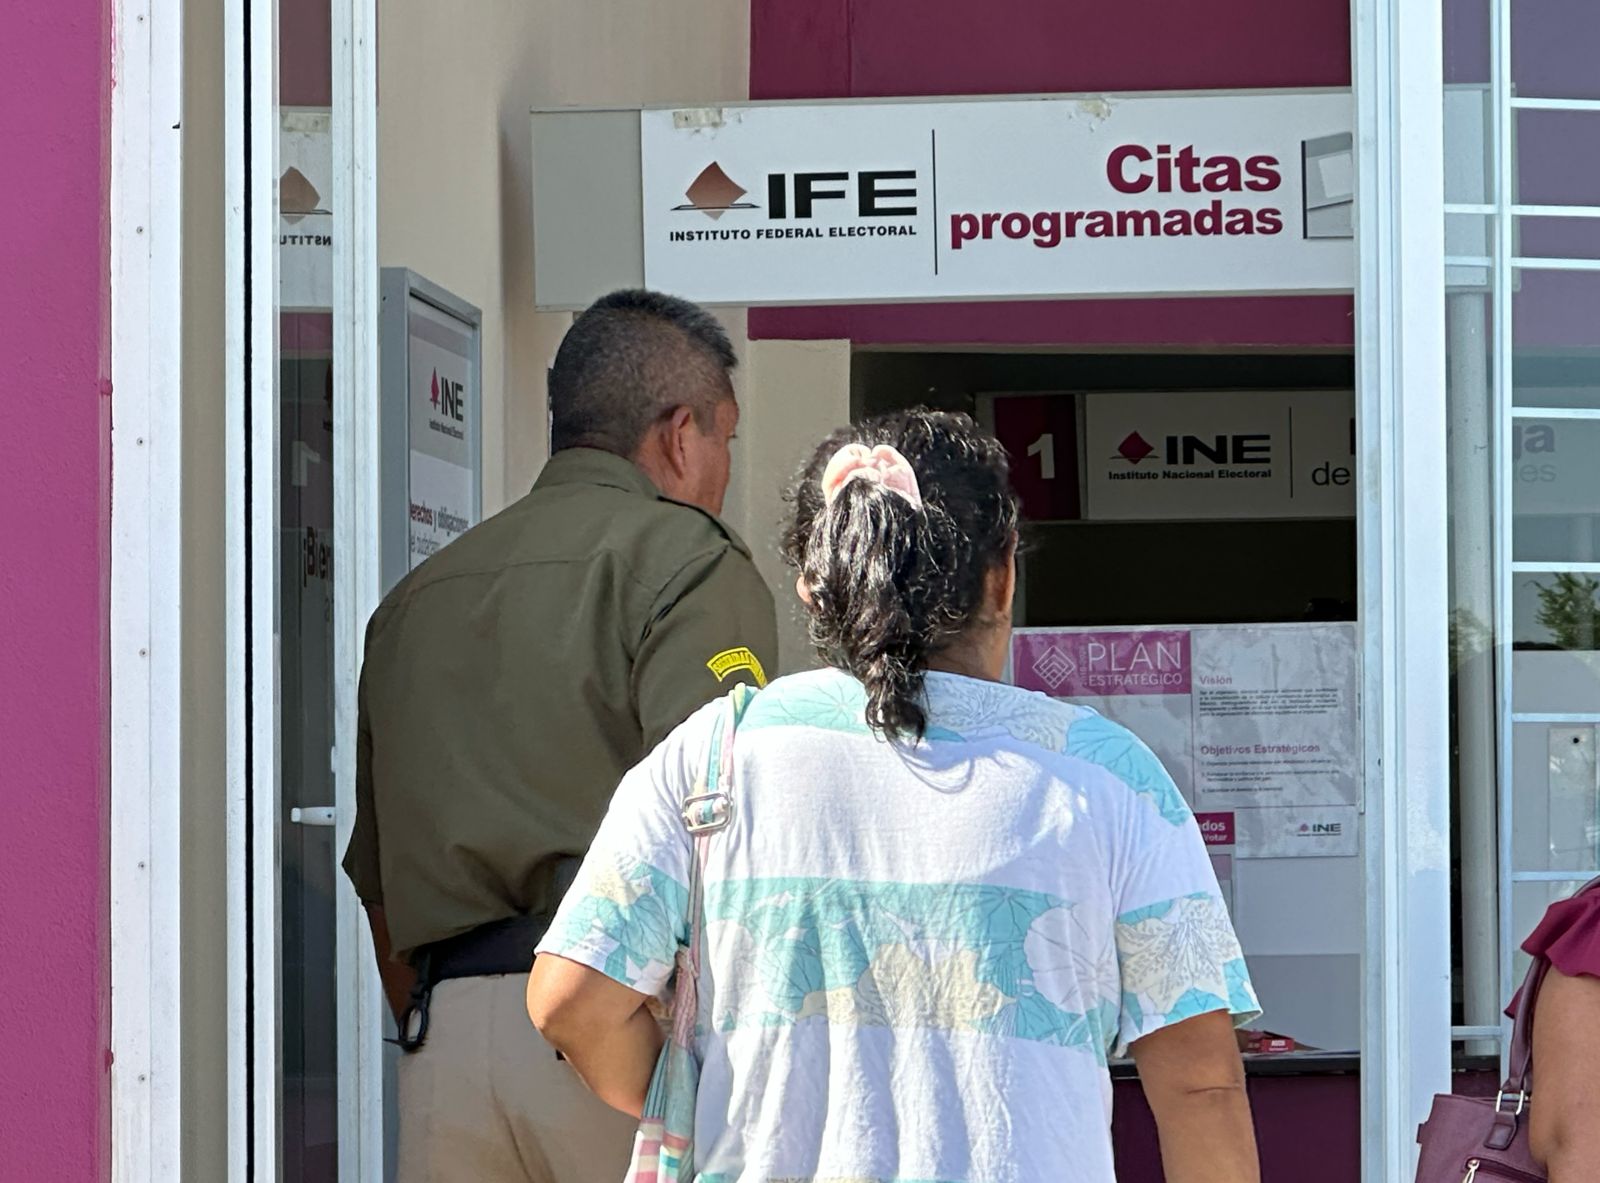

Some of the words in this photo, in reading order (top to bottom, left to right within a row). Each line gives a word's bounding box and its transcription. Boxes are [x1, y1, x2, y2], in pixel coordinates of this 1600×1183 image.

[1106, 144, 1282, 194] Citas
[768, 170, 917, 219] IFE
[669, 229, 751, 242] INSTITUTO
[756, 227, 824, 240] FEDERAL
[828, 225, 917, 238] ELECTORAL
[950, 200, 1283, 250] programadas
[441, 376, 464, 423] INE
[1027, 433, 1055, 479] 1
[1166, 434, 1271, 465] INE
[1108, 470, 1160, 481] Instituto
[1162, 469, 1215, 480] Nacional
[1218, 468, 1273, 479] Electoral
[1311, 461, 1350, 487] de
[1088, 641, 1181, 672] PLAN
[1199, 674, 1233, 686] Visión
[1312, 823, 1342, 833] INE
